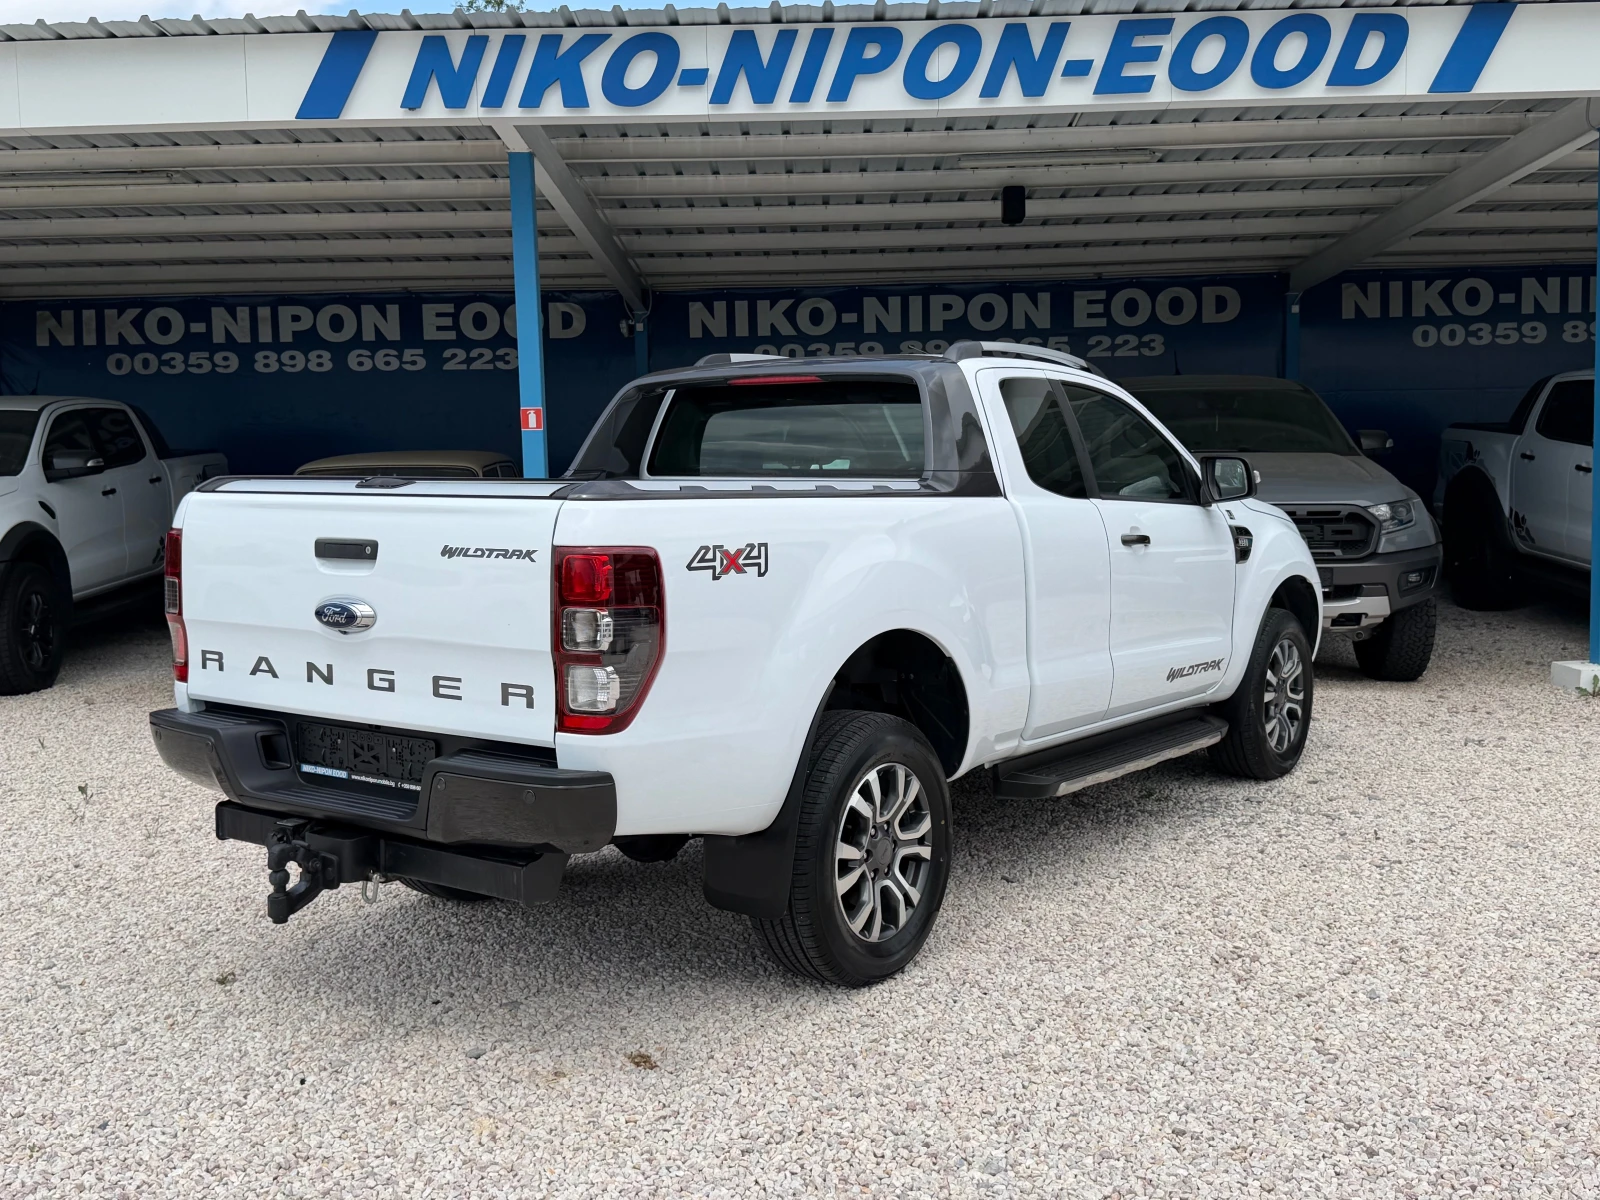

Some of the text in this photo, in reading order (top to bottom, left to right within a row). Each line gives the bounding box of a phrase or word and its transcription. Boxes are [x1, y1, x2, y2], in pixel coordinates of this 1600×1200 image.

[401, 13, 1410, 109] NIKO-NIPON-EOOD
[1342, 276, 1597, 319] NIKO-NI
[36, 304, 401, 347] NIKO-NIPON
[689, 286, 1242, 339] NIKO-NIPON EOOD
[1086, 334, 1166, 358] 223
[1412, 321, 1548, 347] 00359
[106, 347, 520, 376] 00359 898 665 223
[440, 544, 539, 563] WILDTRAK
[321, 606, 348, 624] Ford
[201, 649, 535, 709] RANGER
[1166, 657, 1226, 683] WILDTRAK
